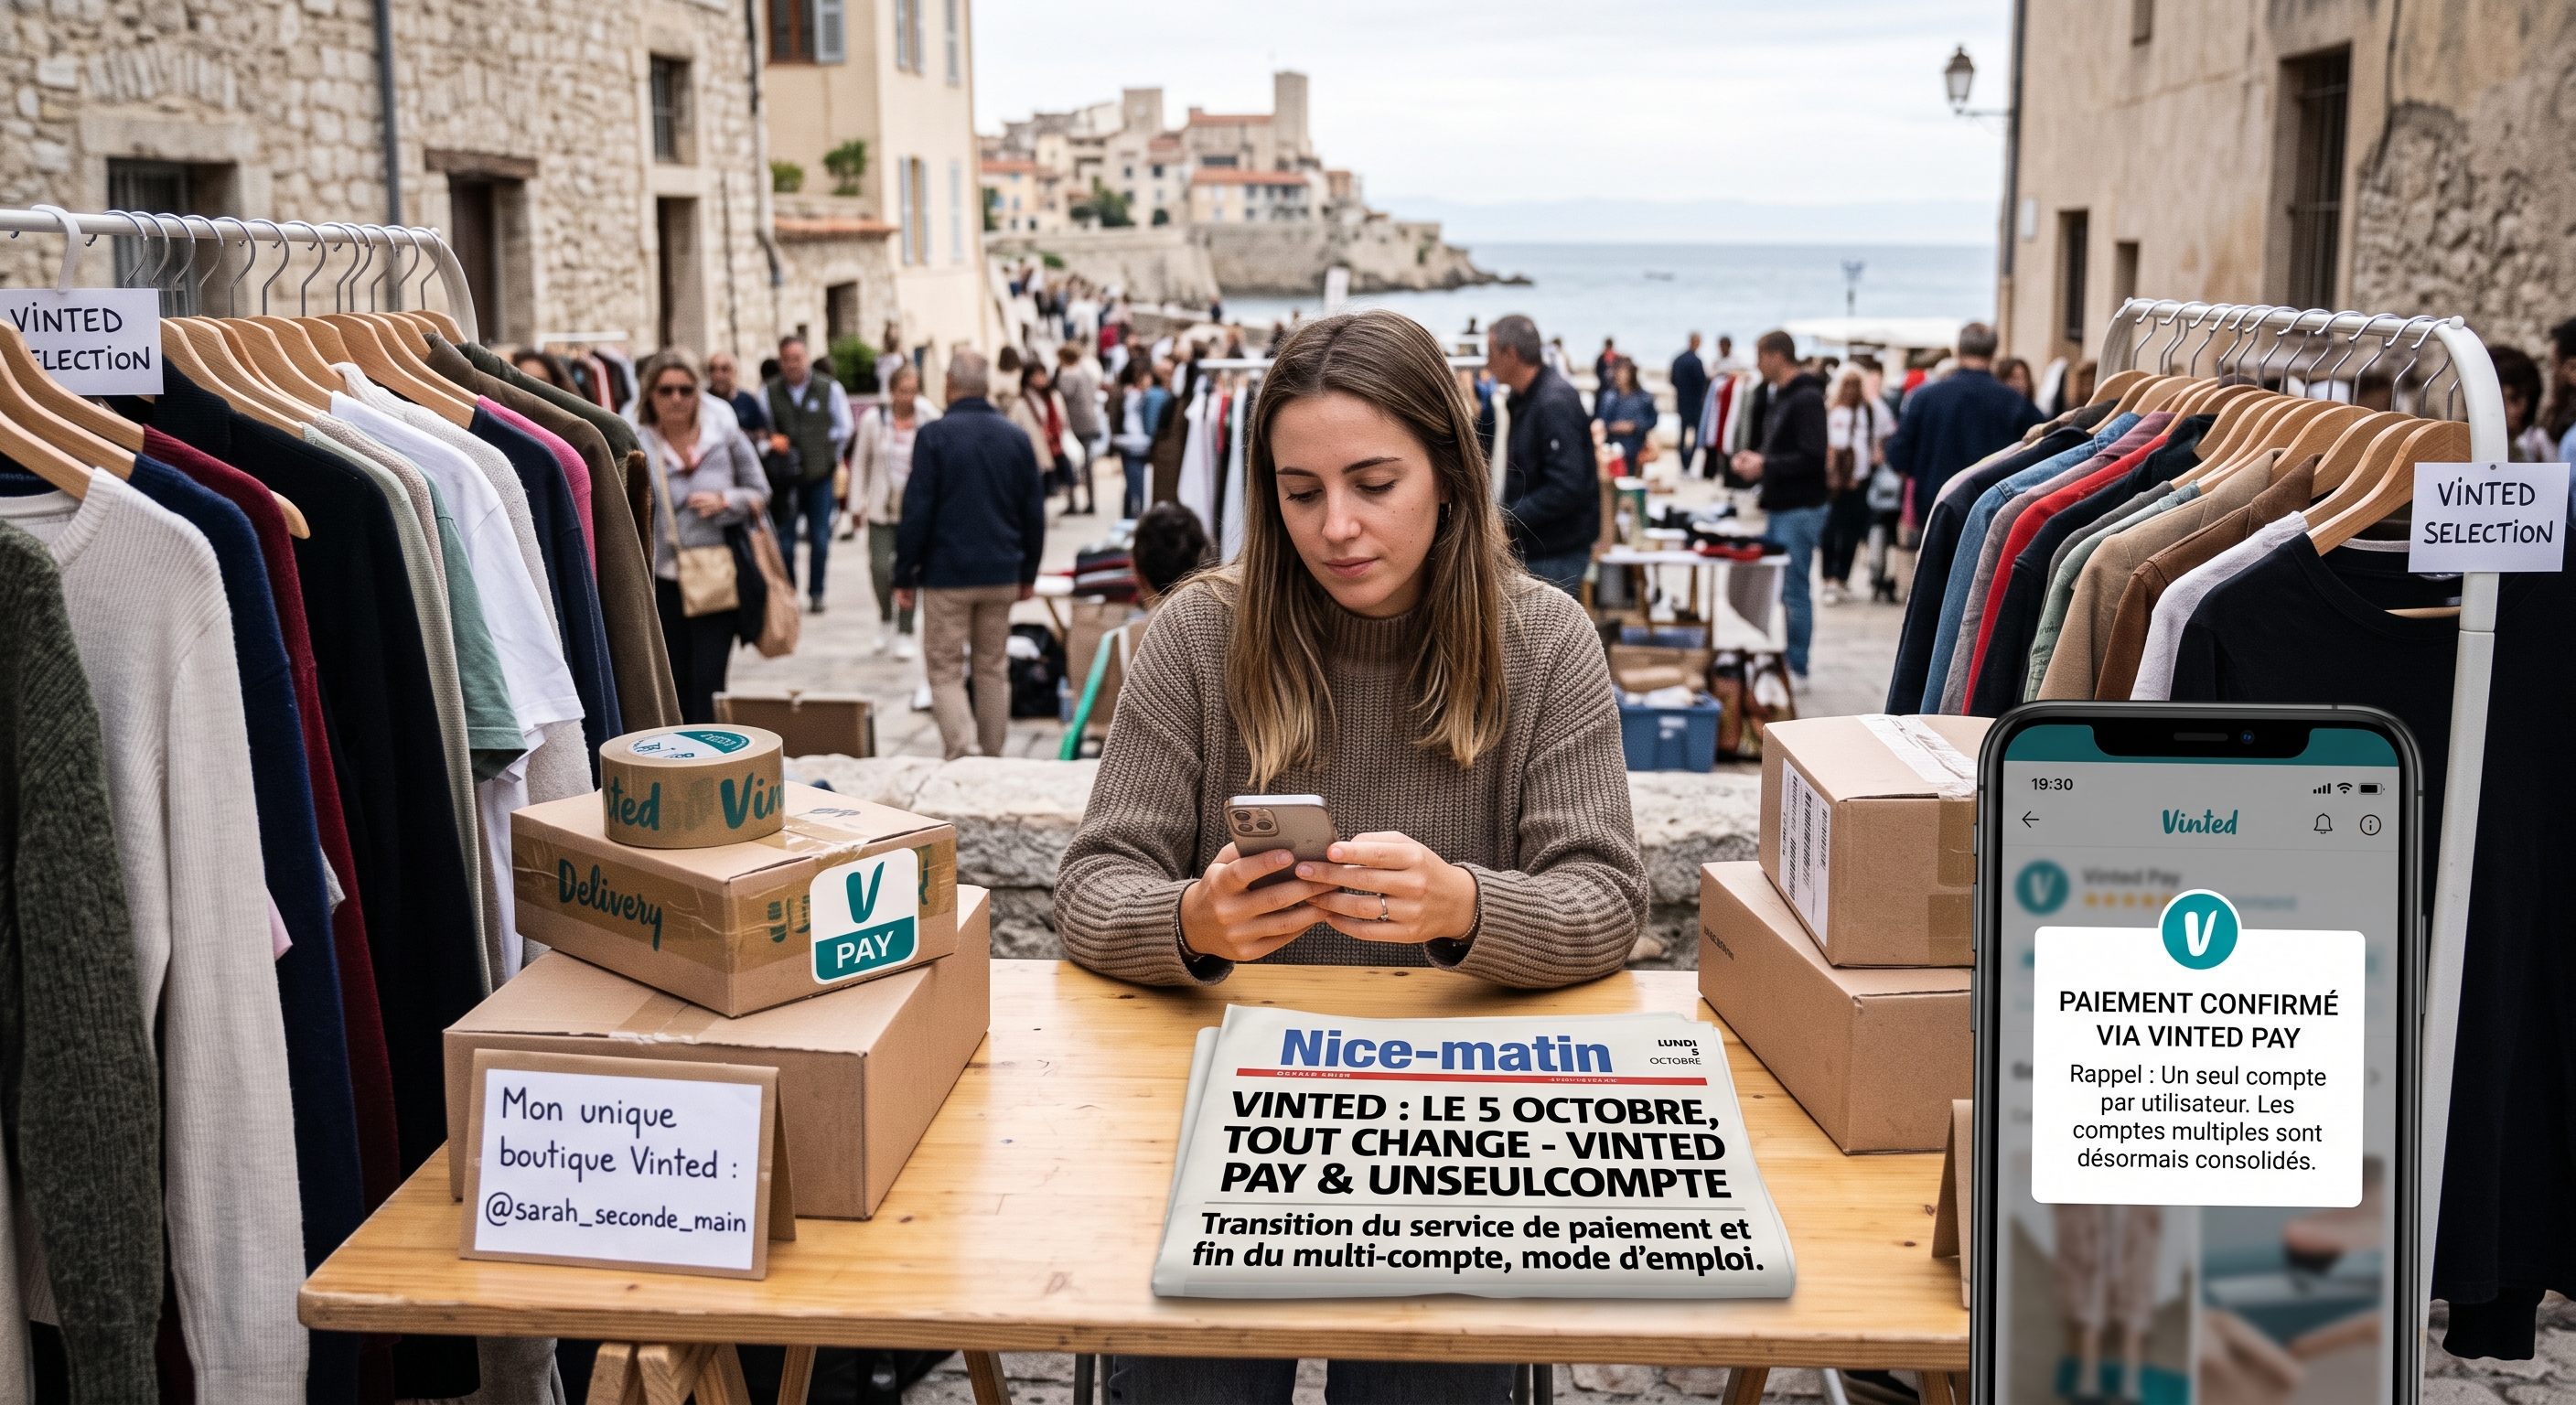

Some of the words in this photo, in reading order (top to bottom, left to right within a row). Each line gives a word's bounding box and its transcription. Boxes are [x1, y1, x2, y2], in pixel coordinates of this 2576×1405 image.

[2031, 778, 2074, 791] 19:30
[2162, 809, 2238, 835] Vinted
[559, 860, 661, 949] Delivery
[846, 862, 885, 924] V
[837, 930, 895, 970] PAY
[2060, 991, 2194, 1014] PAIEMENT
[2200, 989, 2339, 1016] CONFIRMÉ
[1281, 1029, 1613, 1073] Nice-matin
[1658, 1039, 1698, 1047] LUNDI
[2096, 1024, 2141, 1046] VIA
[2147, 1025, 2244, 1047] VINTED
[2252, 1026, 2302, 1049] PAY
[1649, 1057, 1701, 1066] OCTOBRE
[2070, 1064, 2141, 1089] Rappel
[2162, 1065, 2189, 1085] Un
[2195, 1065, 2238, 1085] seul
[2246, 1068, 2326, 1091] compte
[502, 1087, 563, 1121] Mon
[580, 1099, 677, 1140] unique
[1232, 1090, 1387, 1121] VINTED
[1422, 1095, 1465, 1122] LE
[1478, 1096, 1501, 1123] 5
[1514, 1098, 1718, 1130] OCTOBRE,
[2101, 1097, 2136, 1116] par
[2141, 1092, 2249, 1114] utilisateur.
[2258, 1094, 2294, 1114] Les
[1223, 1125, 1342, 1155] TOUT
[1351, 1128, 1530, 1159] CHANGE
[1565, 1132, 1726, 1161] VINTED
[2073, 1121, 2165, 1144] comptes
[2173, 1121, 2270, 1146] multiples
[2276, 1124, 2323, 1142] sont
[500, 1135, 617, 1184] boutique
[630, 1145, 717, 1179] Vinted
[2077, 1147, 2189, 1169] désormais
[2195, 1150, 2316, 1171] consolidés.
[1220, 1162, 1308, 1194] PAY
[1317, 1163, 1355, 1195] &
[1368, 1164, 1733, 1198] UNSEULCOMPTE
[485, 1191, 746, 1233] @sarah_seconde_main
[1201, 1212, 1353, 1236] Transition
[1361, 1213, 1401, 1237] du
[1410, 1214, 1515, 1239] service
[1522, 1215, 1561, 1239] de
[1570, 1217, 1717, 1246] paiement
[1721, 1218, 1752, 1240] et
[1192, 1240, 1234, 1267] fin
[1243, 1241, 1284, 1267] du
[1293, 1242, 1512, 1275] multi-compte,
[1522, 1244, 1611, 1271] mode
